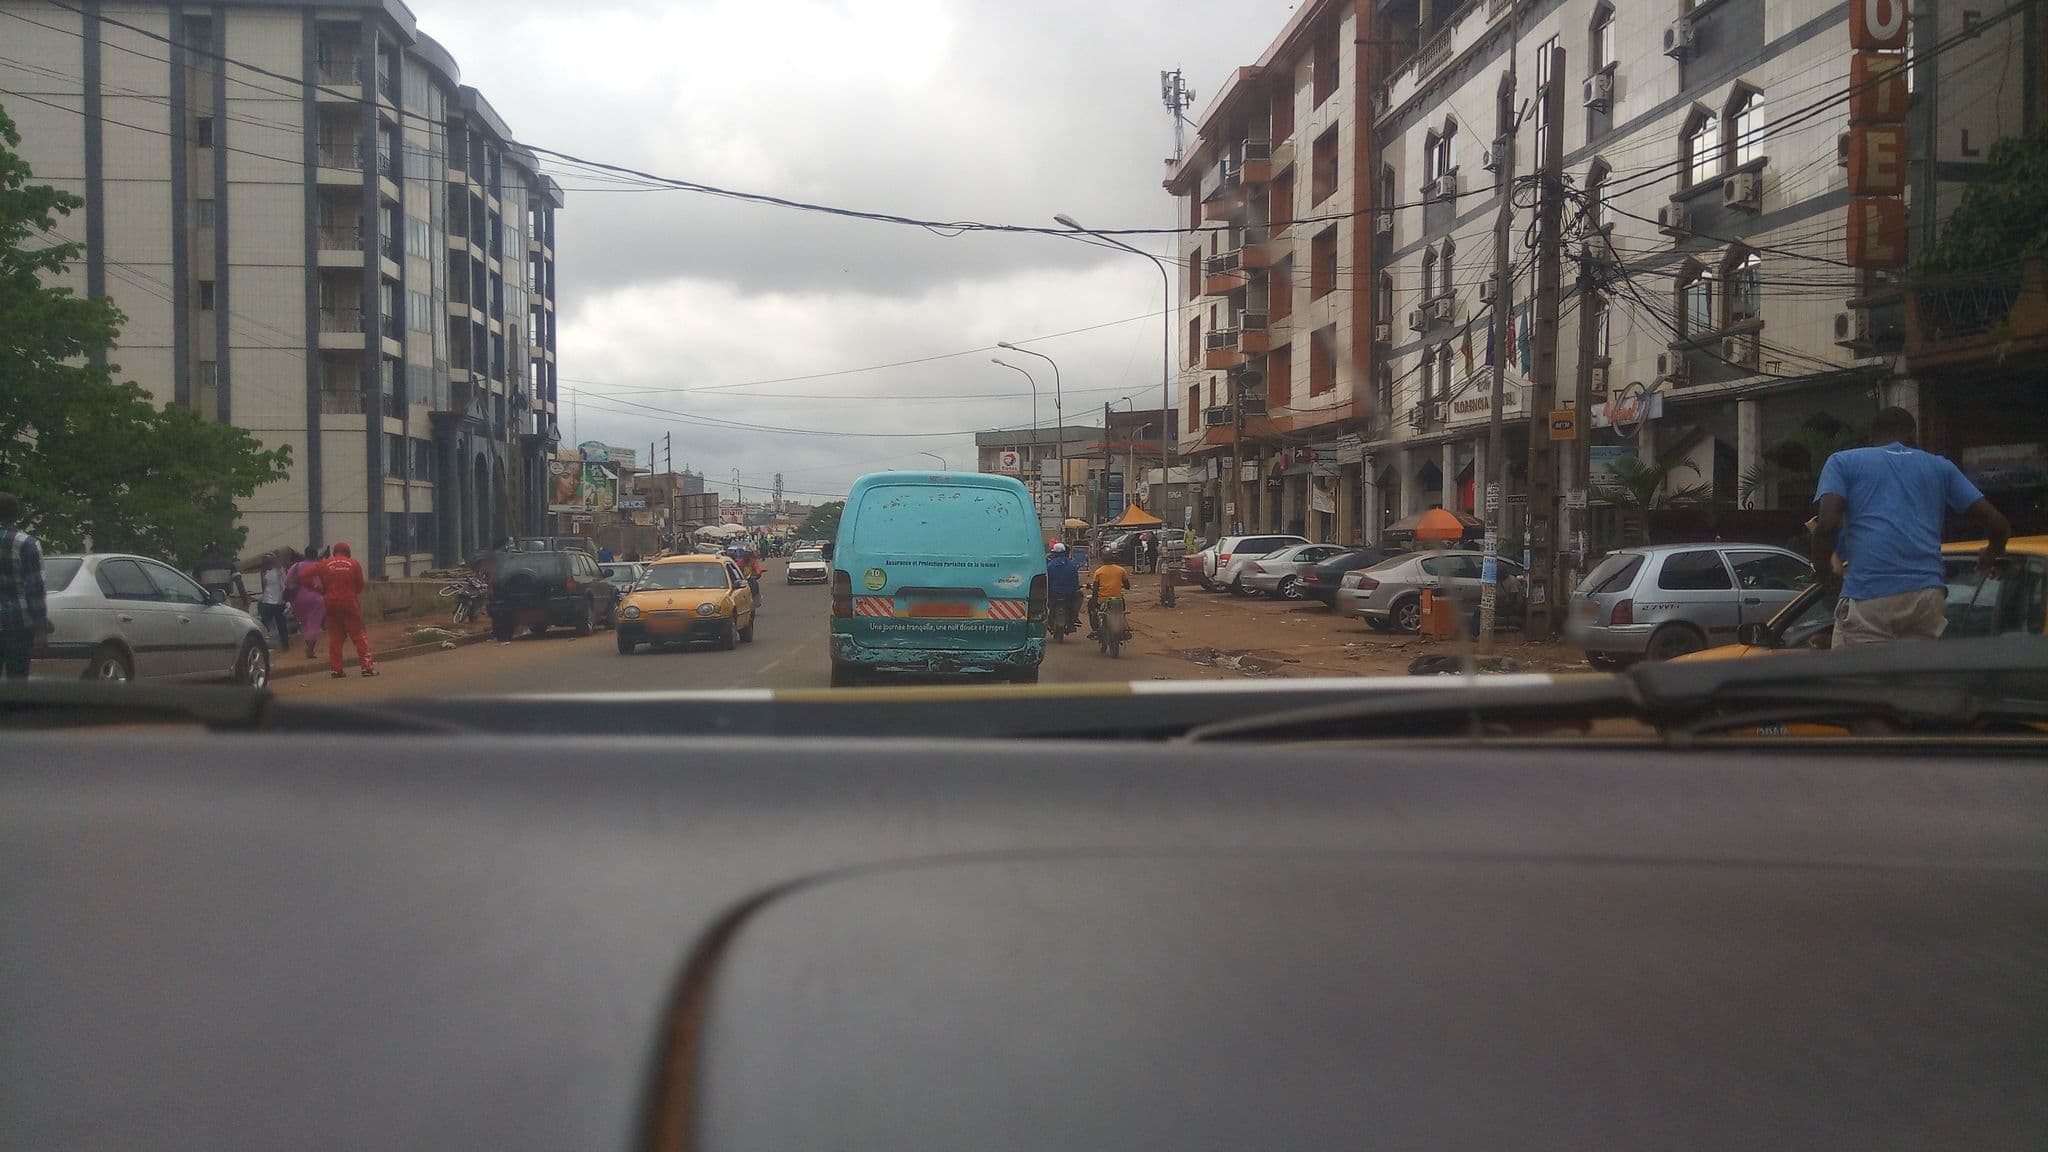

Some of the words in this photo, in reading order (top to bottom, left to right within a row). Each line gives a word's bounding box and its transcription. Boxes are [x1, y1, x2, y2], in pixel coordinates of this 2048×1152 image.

[947, 623, 959, 631] nuit
[960, 623, 977, 631] douce
[985, 624, 1004, 633] propre
